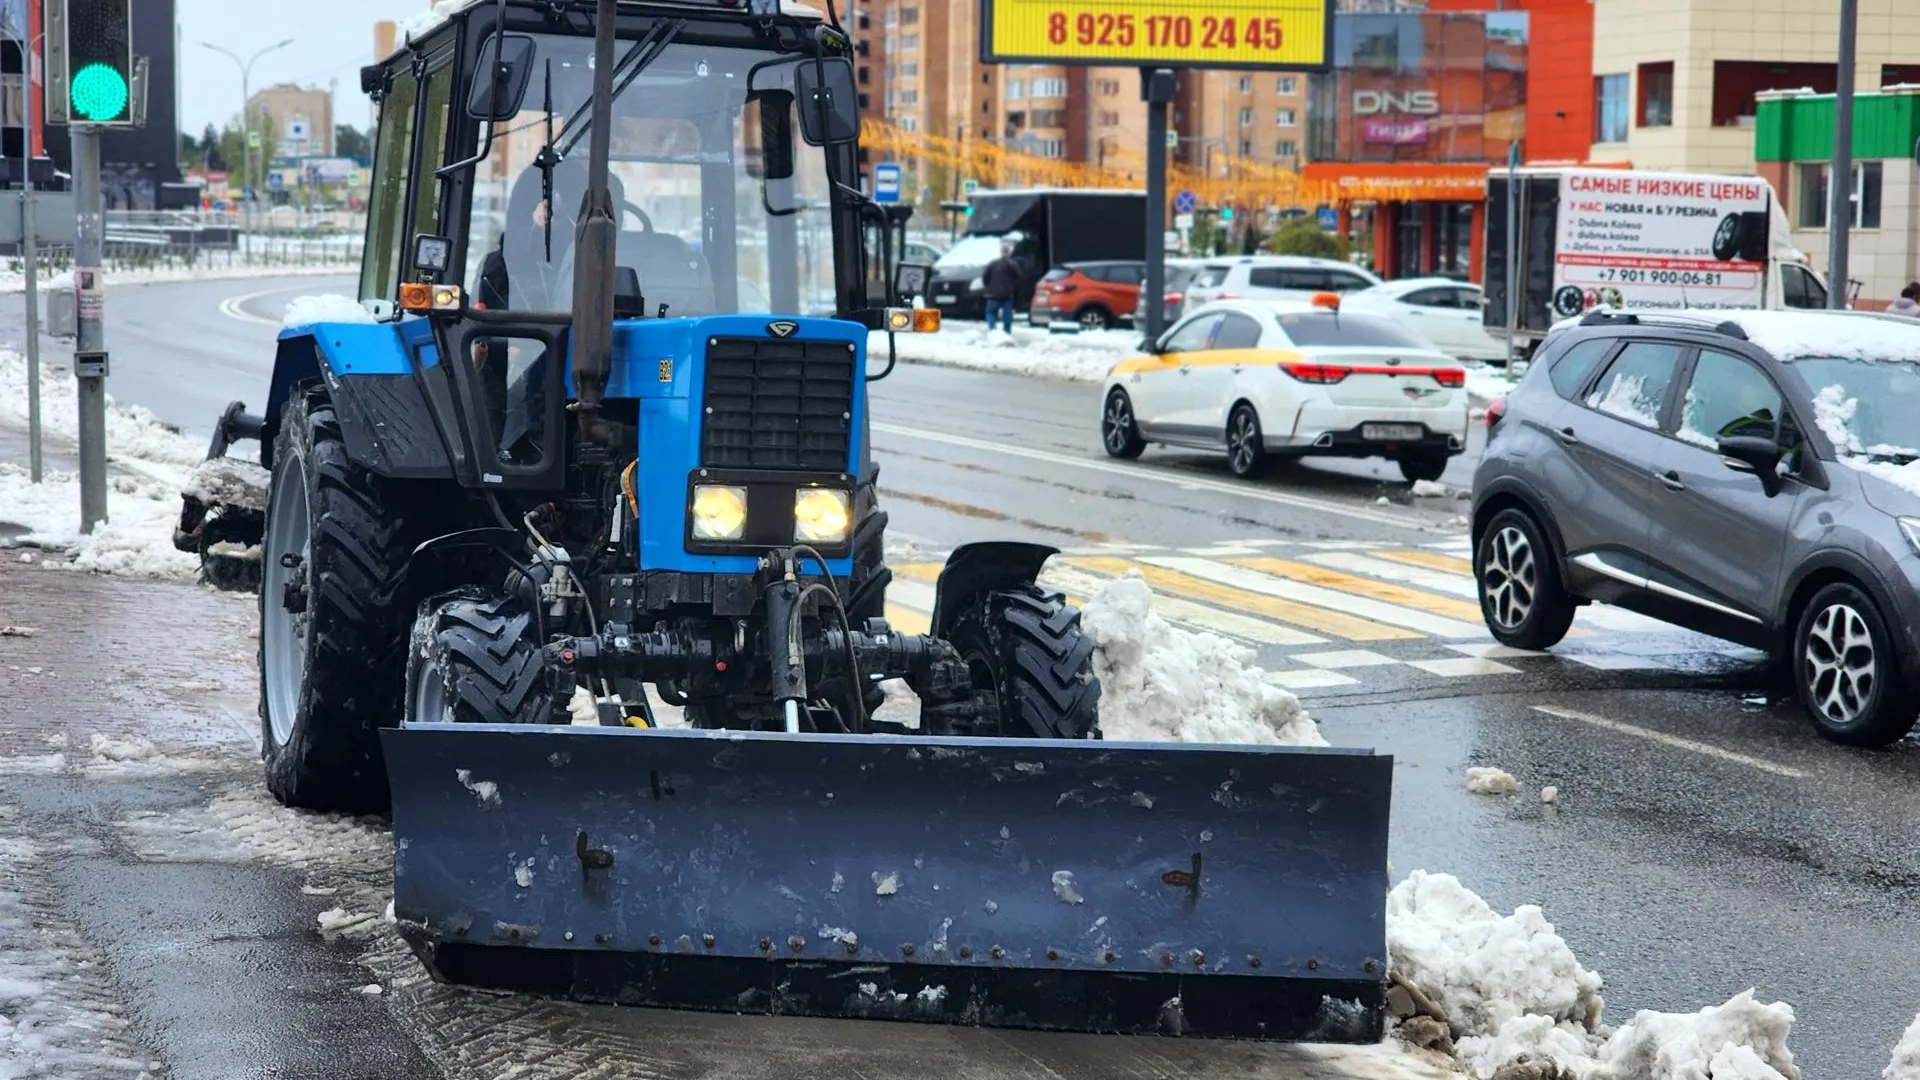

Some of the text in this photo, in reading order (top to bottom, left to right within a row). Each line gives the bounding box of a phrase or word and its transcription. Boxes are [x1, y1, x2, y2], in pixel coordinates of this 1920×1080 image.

[1048, 12, 1283, 50] 8 925 170 24 45
[1352, 90, 1440, 114] DNS
[1569, 176, 1760, 203] САМЫЕ НИЗКИЕ ЦЕНЫ
[1568, 201, 1576, 210] У
[1579, 202, 1601, 213] НАС
[1605, 203, 1644, 215] НОВАЯ
[1675, 206, 1718, 218] РЕЗИНА
[1577, 217, 1609, 228] Dubna
[1598, 268, 1722, 285] +7 901 900-06-81
